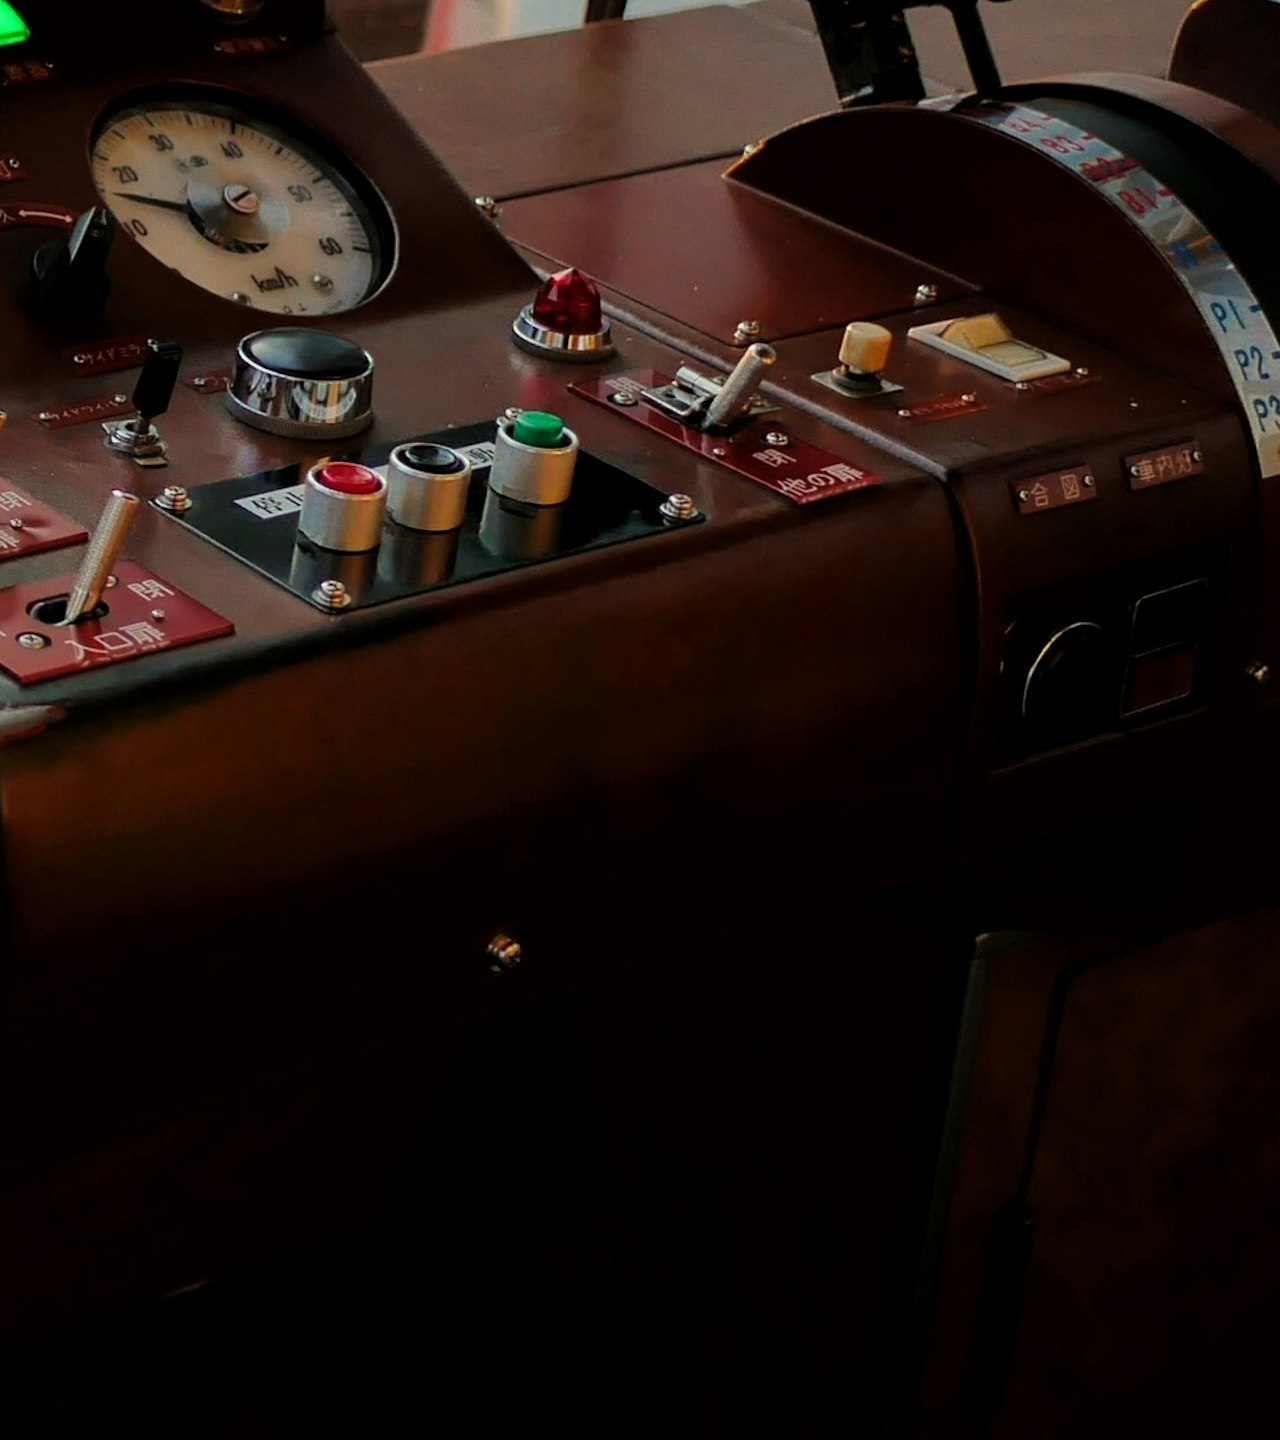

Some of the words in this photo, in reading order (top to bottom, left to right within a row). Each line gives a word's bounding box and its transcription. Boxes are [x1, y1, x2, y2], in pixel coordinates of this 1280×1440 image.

[148, 133, 175, 152] 30
[219, 141, 244, 160] 40
[1040, 136, 1085, 154] B3
[111, 165, 139, 184] 20
[287, 184, 313, 204] 50
[1118, 186, 1159, 216] B1
[124, 218, 150, 238] 10
[318, 236, 343, 257] 60
[250, 266, 300, 294] km/h
[1209, 298, 1246, 334] P1
[1233, 345, 1271, 381] P2
[1252, 394, 1280, 434] P3
[1136, 448, 1193, 480] 車内灯
[775, 461, 866, 497] 他の扉
[1029, 472, 1081, 507] 合図
[127, 579, 176, 603] 閉
[63, 621, 167, 664] 入口扉
